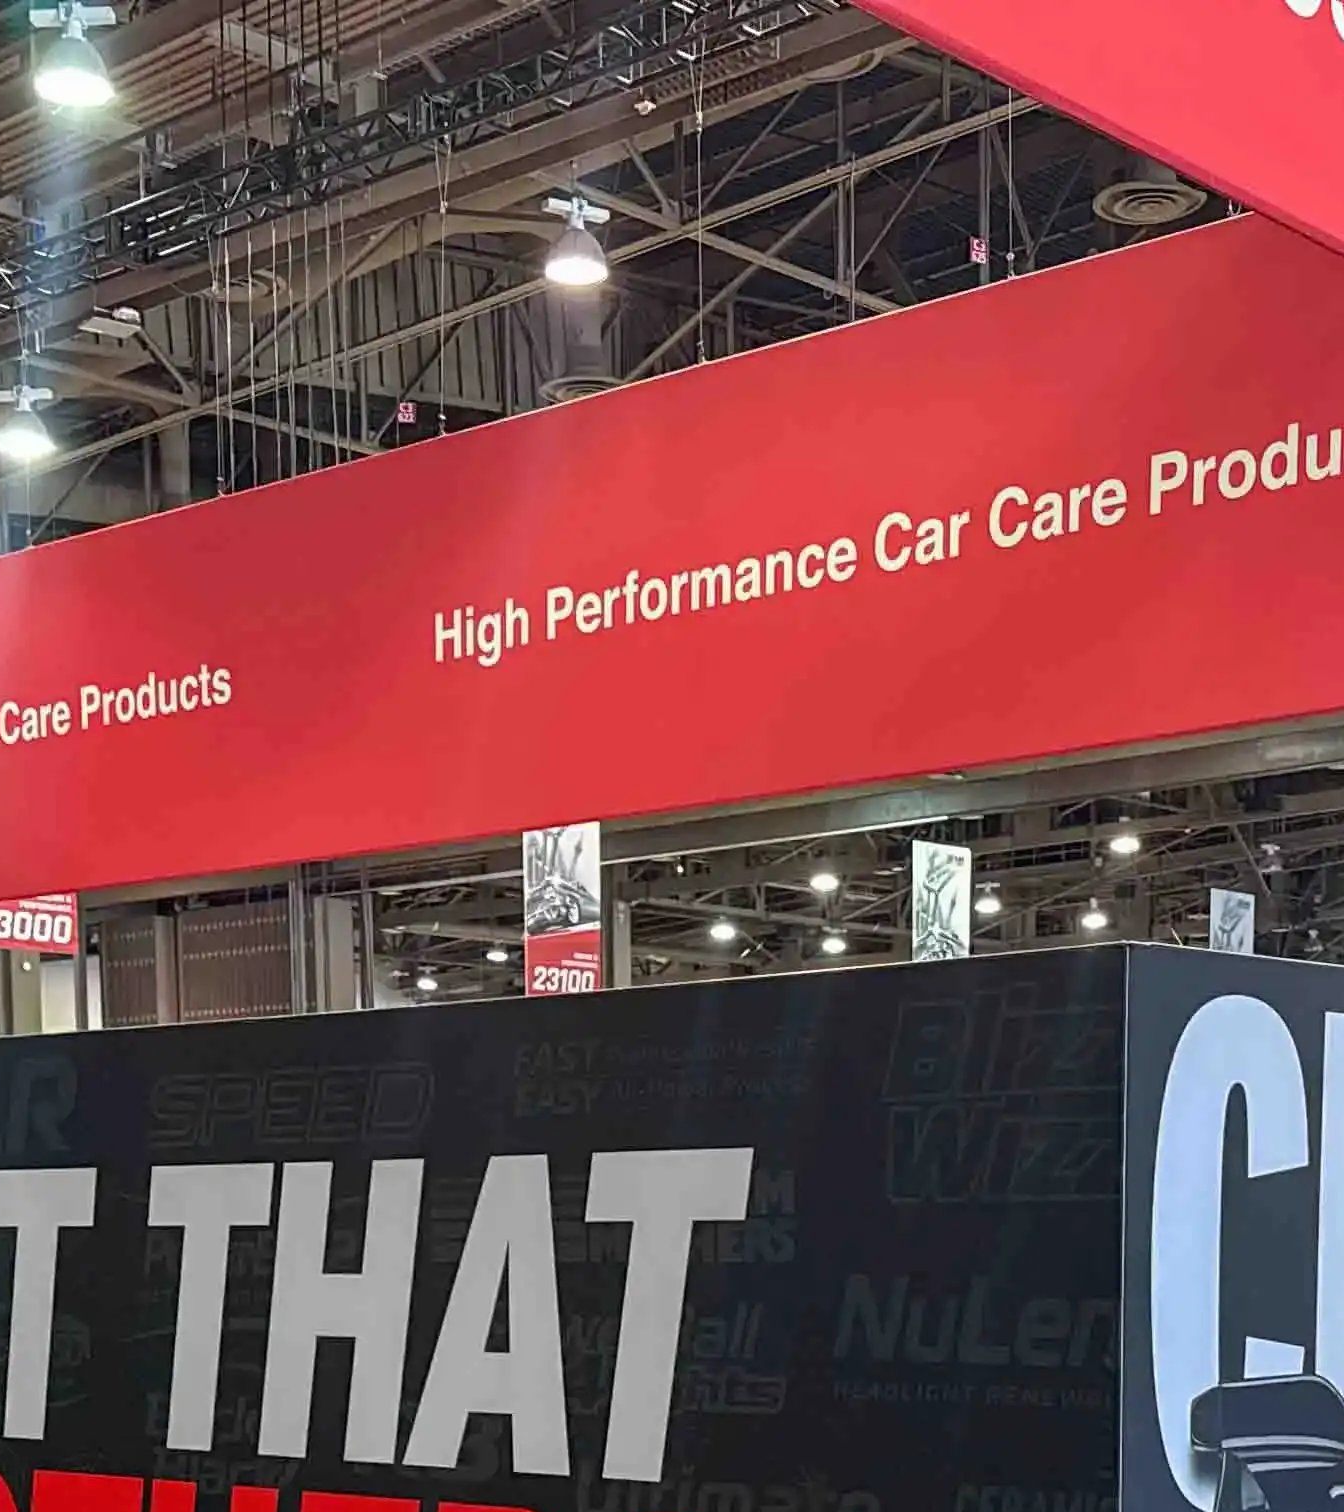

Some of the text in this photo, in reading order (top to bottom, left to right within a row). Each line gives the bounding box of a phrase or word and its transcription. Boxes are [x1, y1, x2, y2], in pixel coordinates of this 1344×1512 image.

[436, 599, 530, 668] High
[548, 539, 858, 641] Performance
[875, 512, 971, 573] Car
[990, 479, 1128, 549] Care
[0, 702, 72, 746] Care
[81, 665, 233, 731] Products
[532, 965, 596, 993] 23100
[149, 1062, 435, 1149] SPEED
[145, 1144, 756, 1485] THAT
